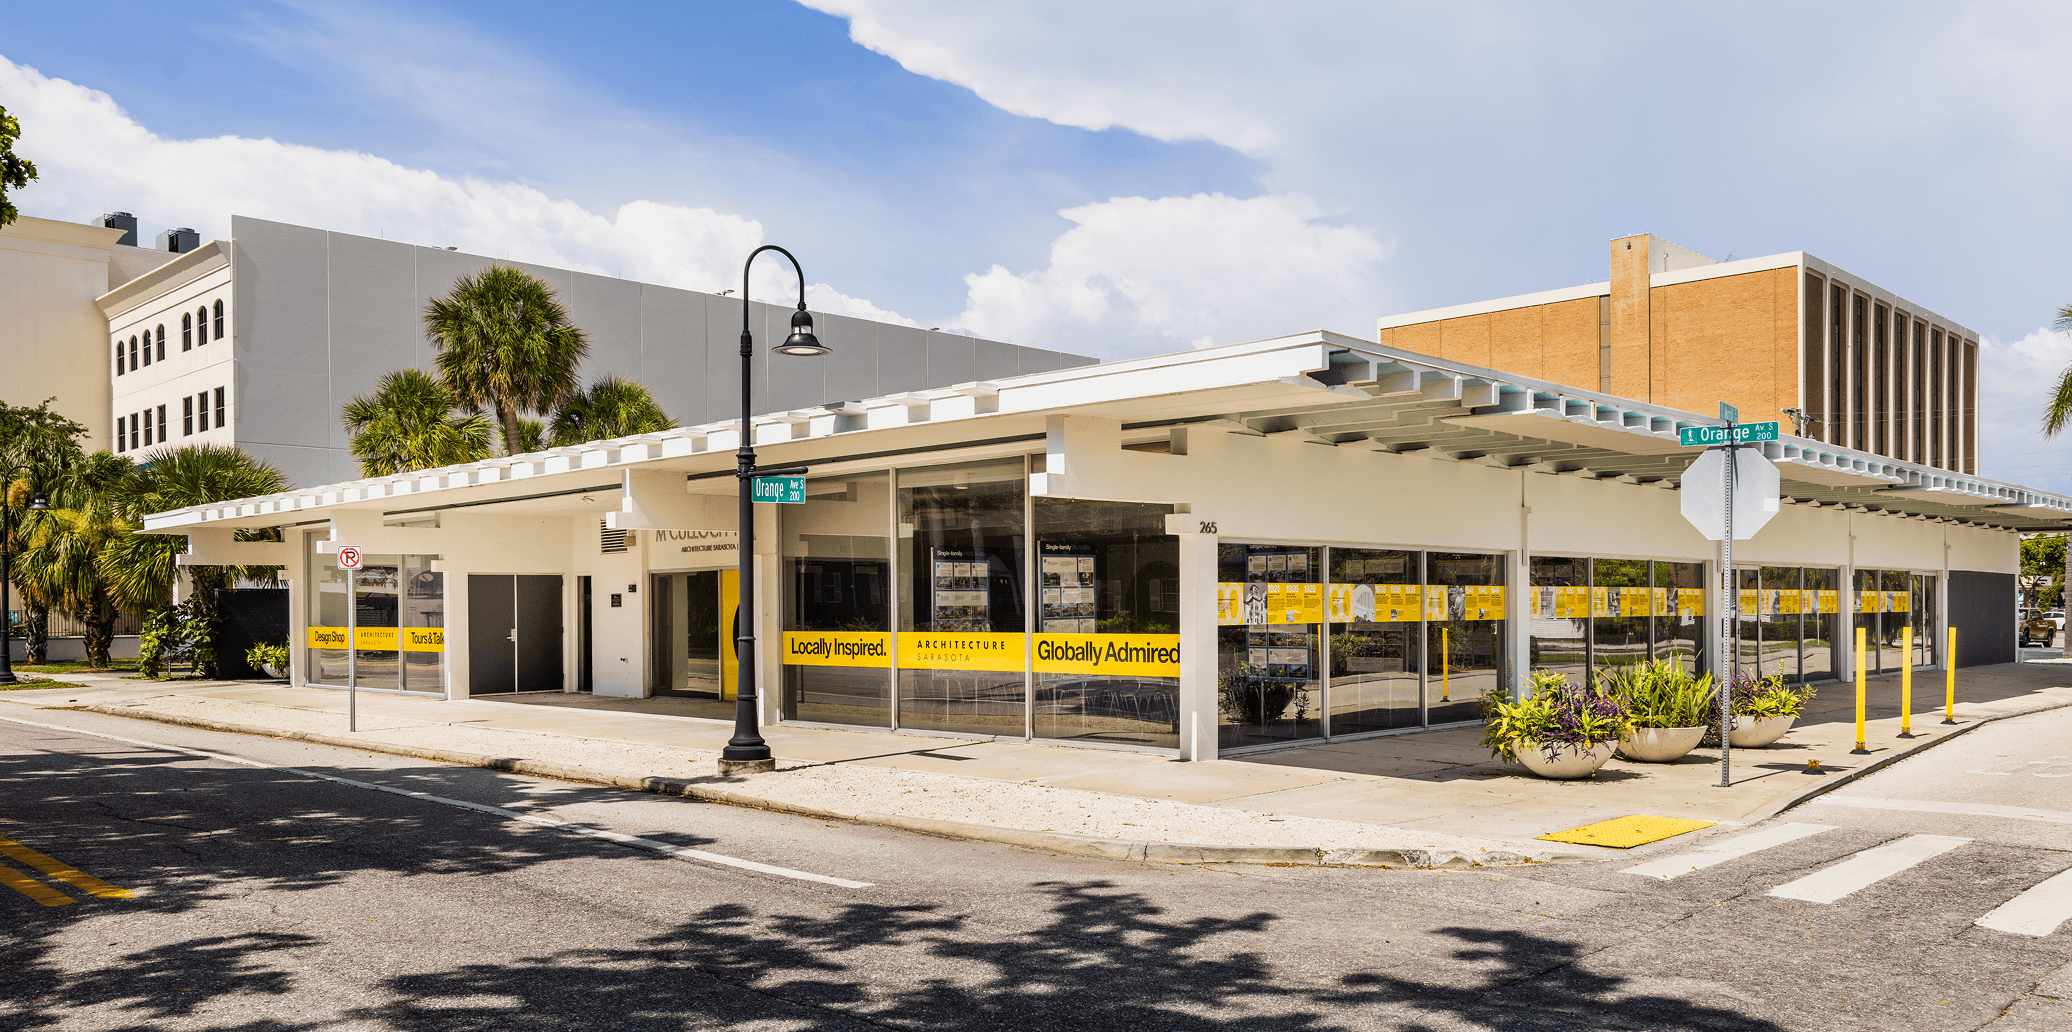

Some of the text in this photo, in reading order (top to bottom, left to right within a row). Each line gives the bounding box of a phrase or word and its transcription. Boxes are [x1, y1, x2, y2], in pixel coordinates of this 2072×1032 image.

[1701, 428, 1750, 443] Orange
[1755, 424, 1766, 432] Av.
[1768, 422, 1774, 430] S
[1757, 432, 1772, 440] 200
[756, 478, 804, 502] Orange Ave S
[790, 490, 800, 501] 200
[1200, 521, 1218, 534] 265
[681, 544, 712, 552] ARCHITECTURE
[314, 631, 345, 644] Design Shop
[411, 632, 428, 644] Tours
[428, 632, 432, 644] &
[792, 638, 886, 659] Locally Inspired.
[918, 640, 1005, 650] ARCHITECTURE
[917, 652, 970, 662] SARASOTA
[1038, 640, 1180, 666] Globally Admired
